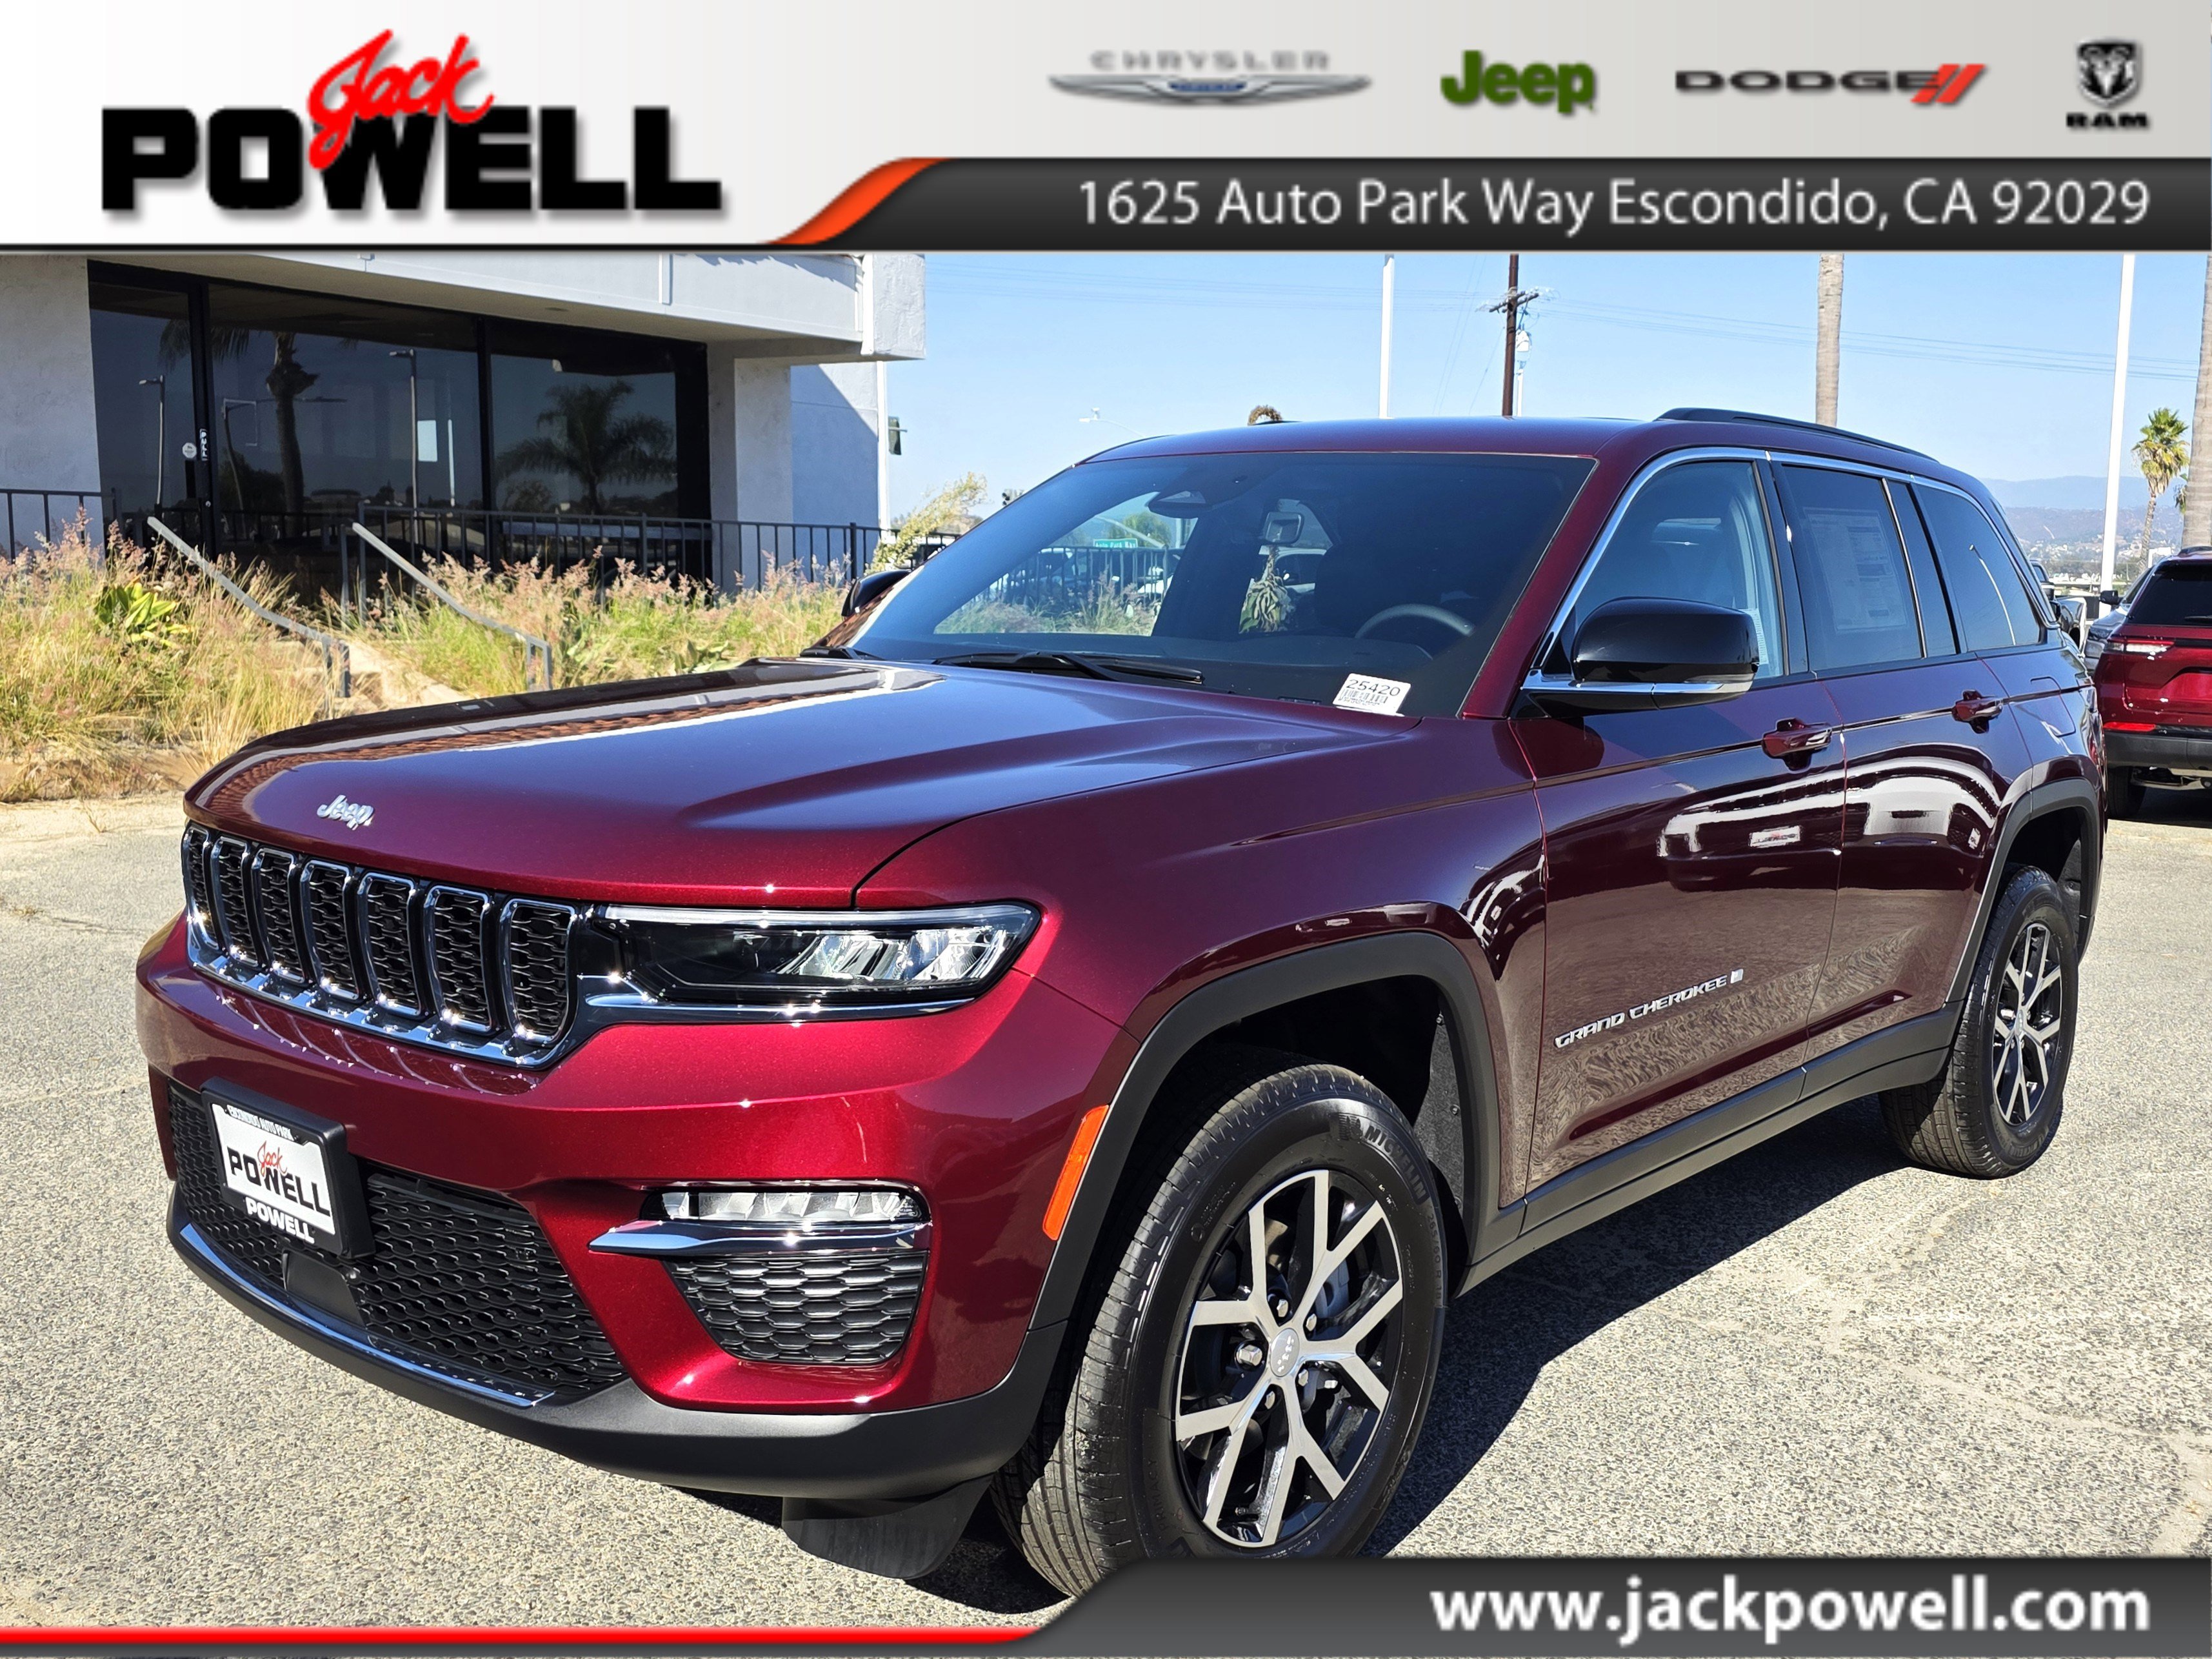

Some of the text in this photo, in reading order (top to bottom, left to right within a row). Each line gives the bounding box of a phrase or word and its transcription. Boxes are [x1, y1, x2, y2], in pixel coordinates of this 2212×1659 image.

[1346, 678, 1401, 697] 25420
[316, 794, 374, 830] Jeep
[1554, 974, 1728, 1049] GRAND CHEROKEE
[257, 1140, 288, 1177] Jack
[1364, 1125, 1428, 1201] MICHELIN
[244, 1196, 315, 1245] POWELL
